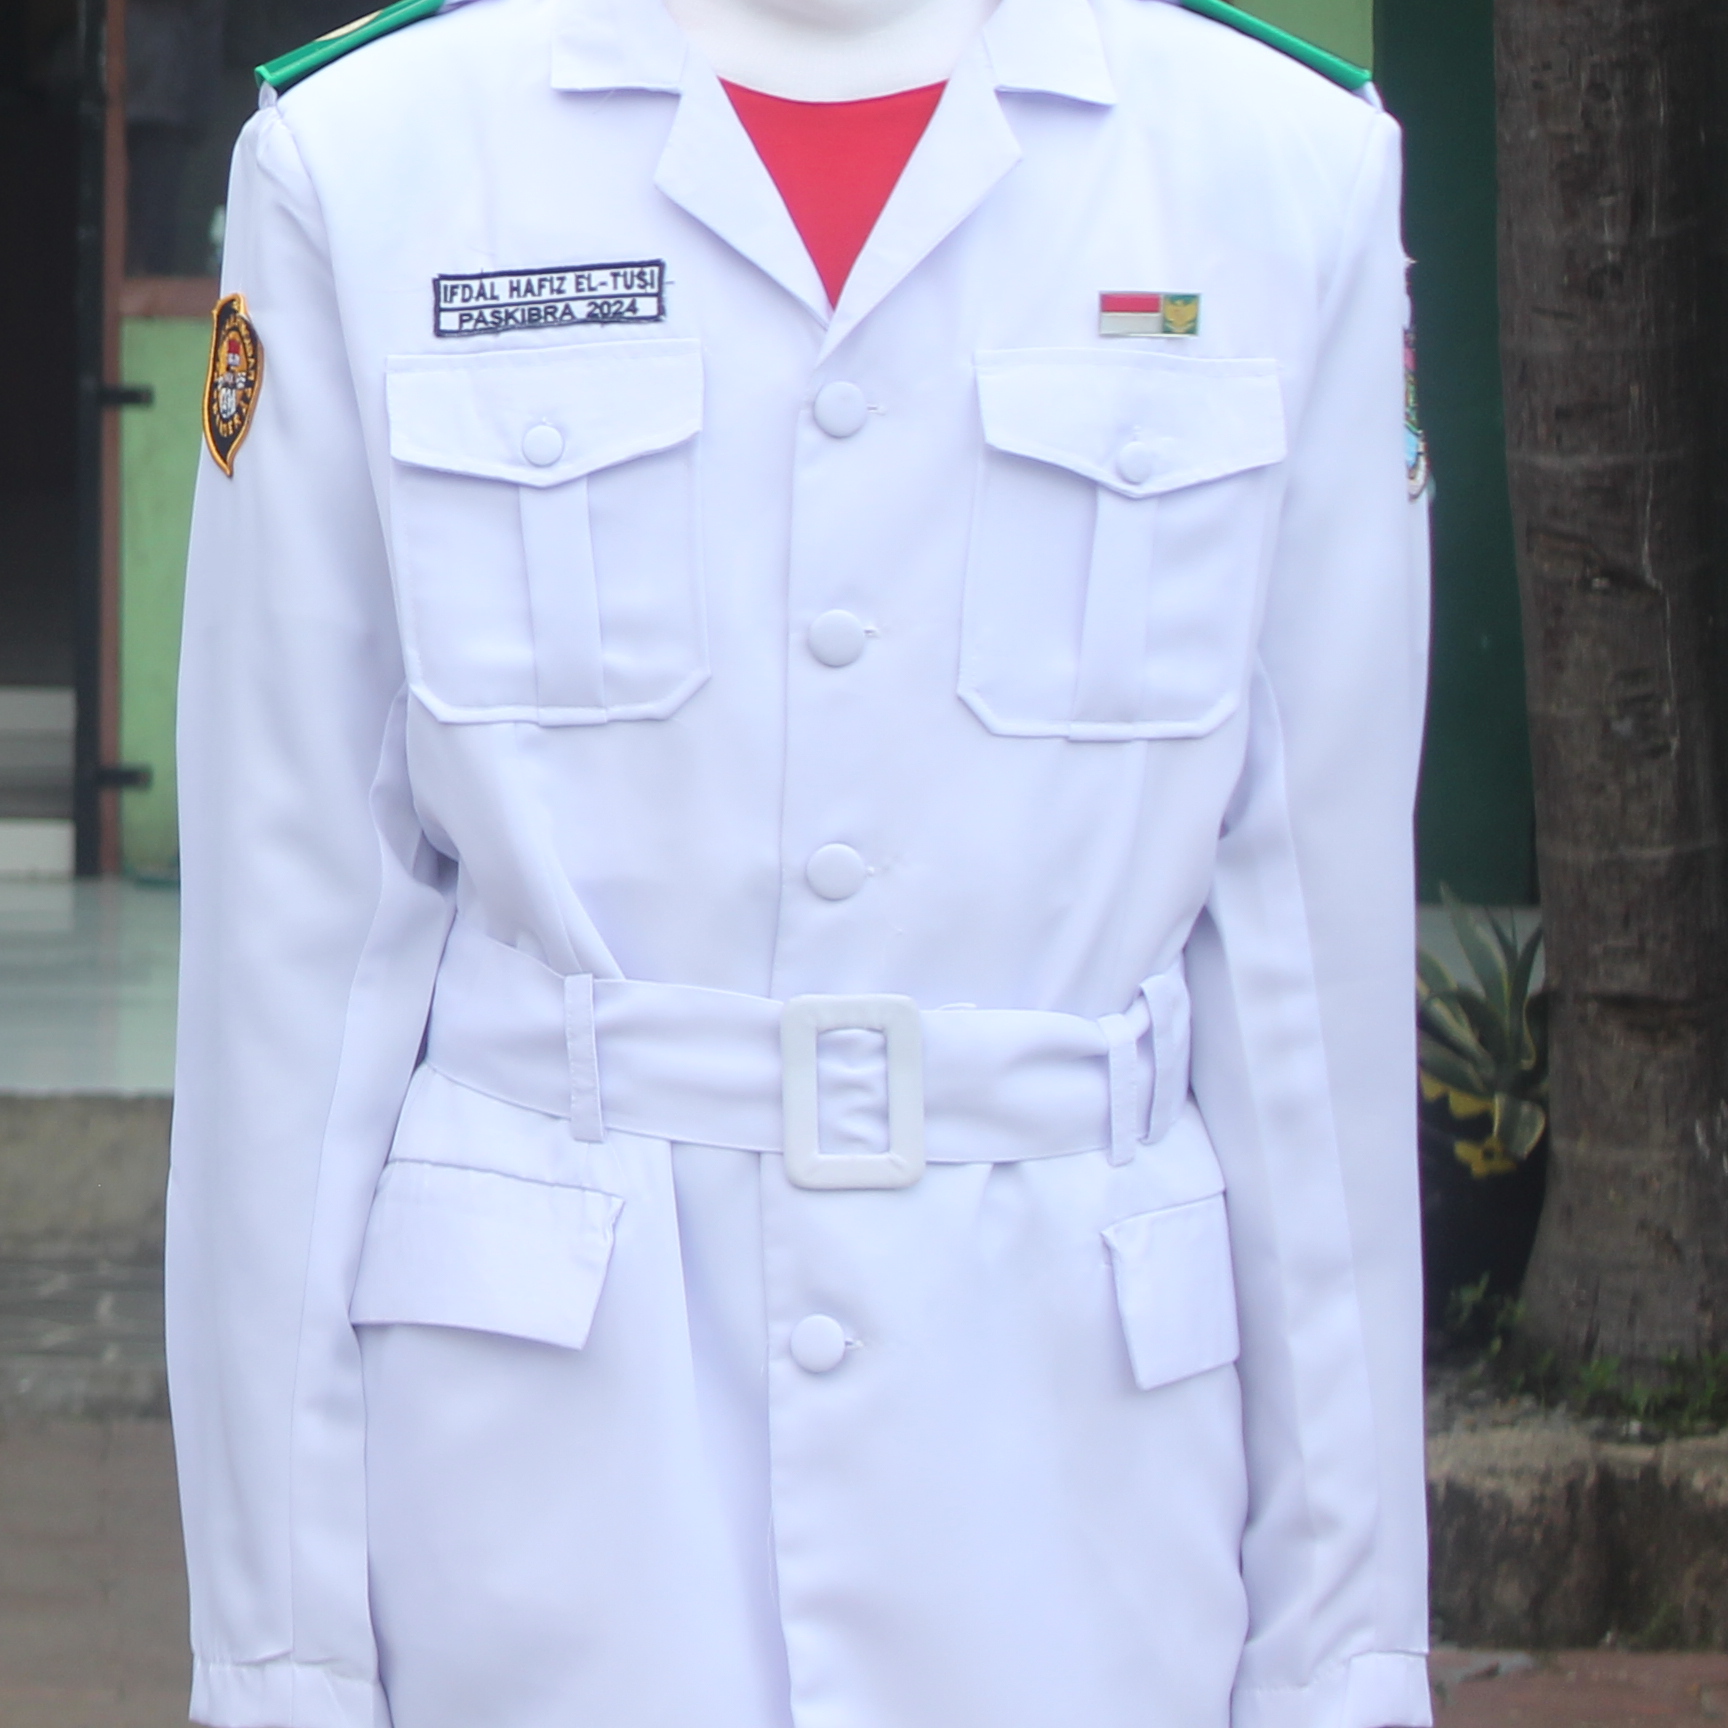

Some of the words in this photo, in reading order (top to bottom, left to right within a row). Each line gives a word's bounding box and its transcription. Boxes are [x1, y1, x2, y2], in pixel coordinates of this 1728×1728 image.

[443, 278, 500, 304] IFDAL
[509, 274, 566, 299] HAFIZ
[575, 269, 656, 293] EL-TUSI
[459, 303, 578, 330] PASKIBRA
[586, 297, 639, 319] 2024
